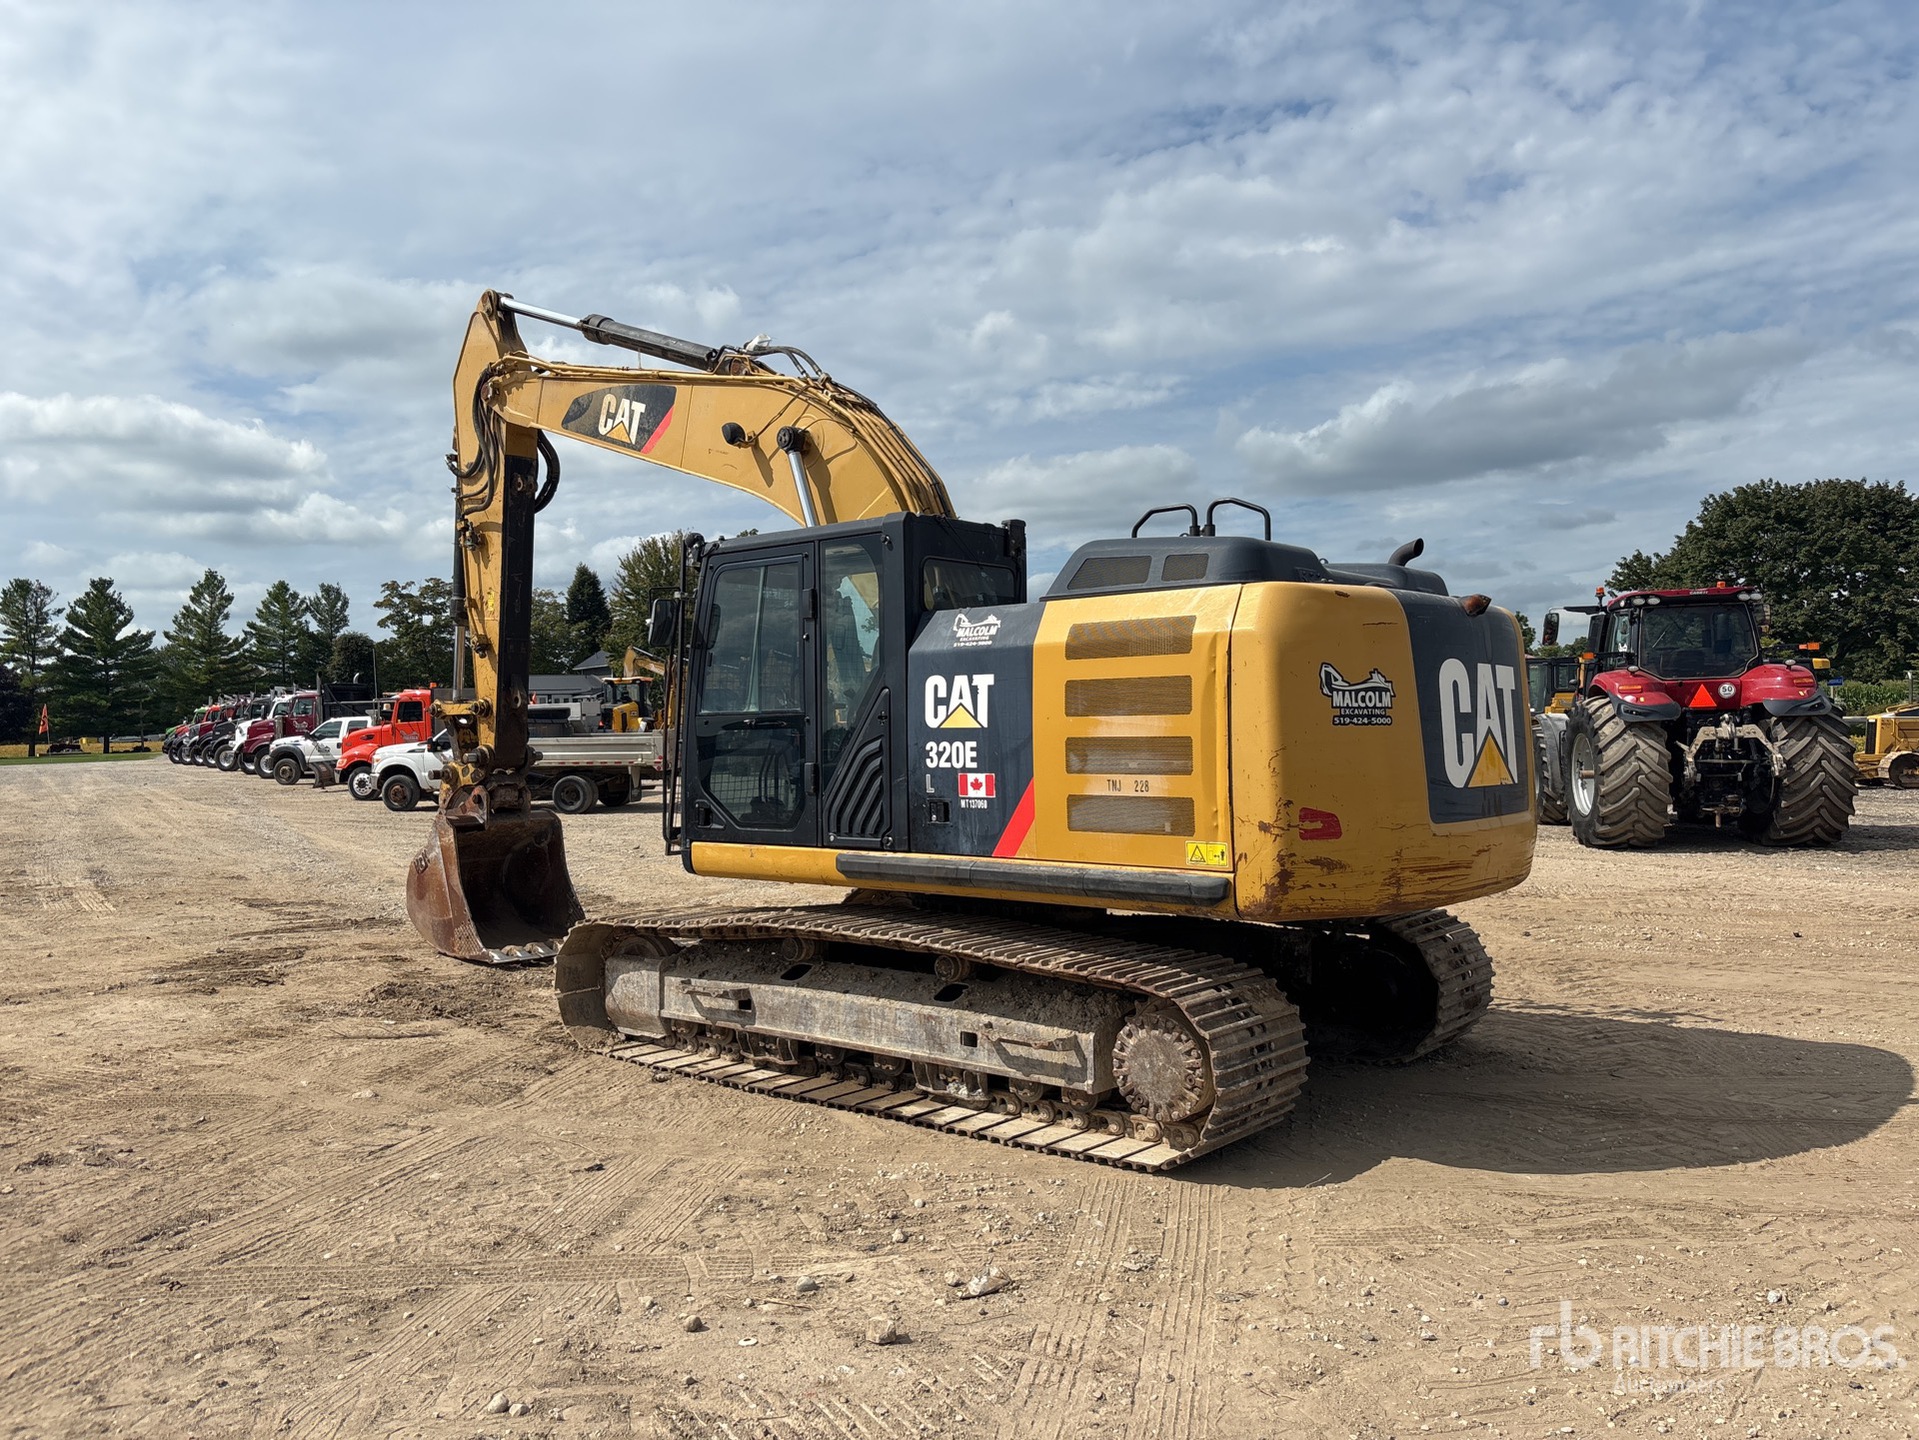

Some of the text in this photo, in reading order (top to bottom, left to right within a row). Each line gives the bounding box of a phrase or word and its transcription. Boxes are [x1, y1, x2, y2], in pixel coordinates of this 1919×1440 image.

[598, 393, 646, 445] CAT
[956, 626, 998, 638] MALCOLM
[924, 674, 995, 729] CAT
[1332, 691, 1392, 708] MALCOLM
[1340, 708, 1386, 716] EXCAVATING
[1438, 658, 1518, 788] CAT
[925, 741, 978, 769] 320E
[1106, 779, 1150, 793] TNJ 228
